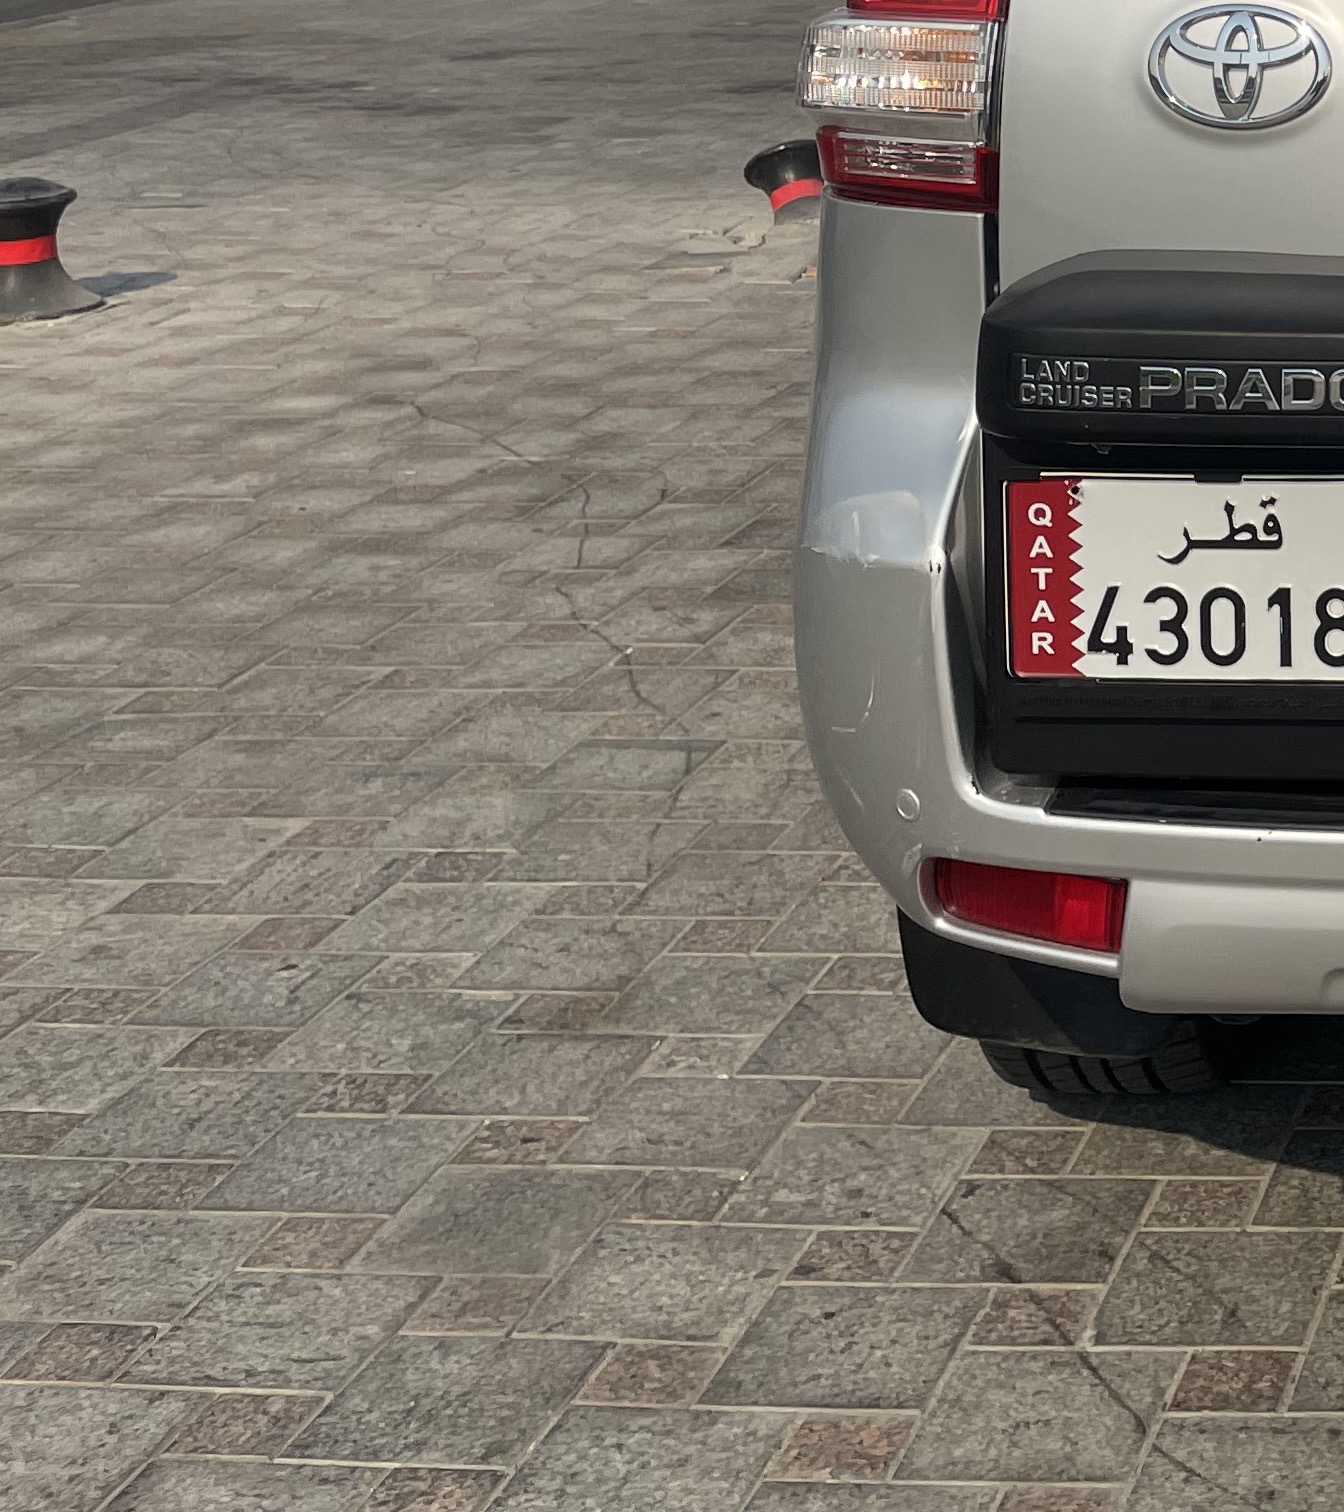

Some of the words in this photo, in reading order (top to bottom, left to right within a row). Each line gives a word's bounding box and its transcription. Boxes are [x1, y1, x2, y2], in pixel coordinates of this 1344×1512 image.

[1020, 358, 1090, 384] LAND
[1018, 383, 1133, 409] CRUISER
[1157, 495, 1283, 565] قطر
[1027, 502, 1055, 656] QATAR
